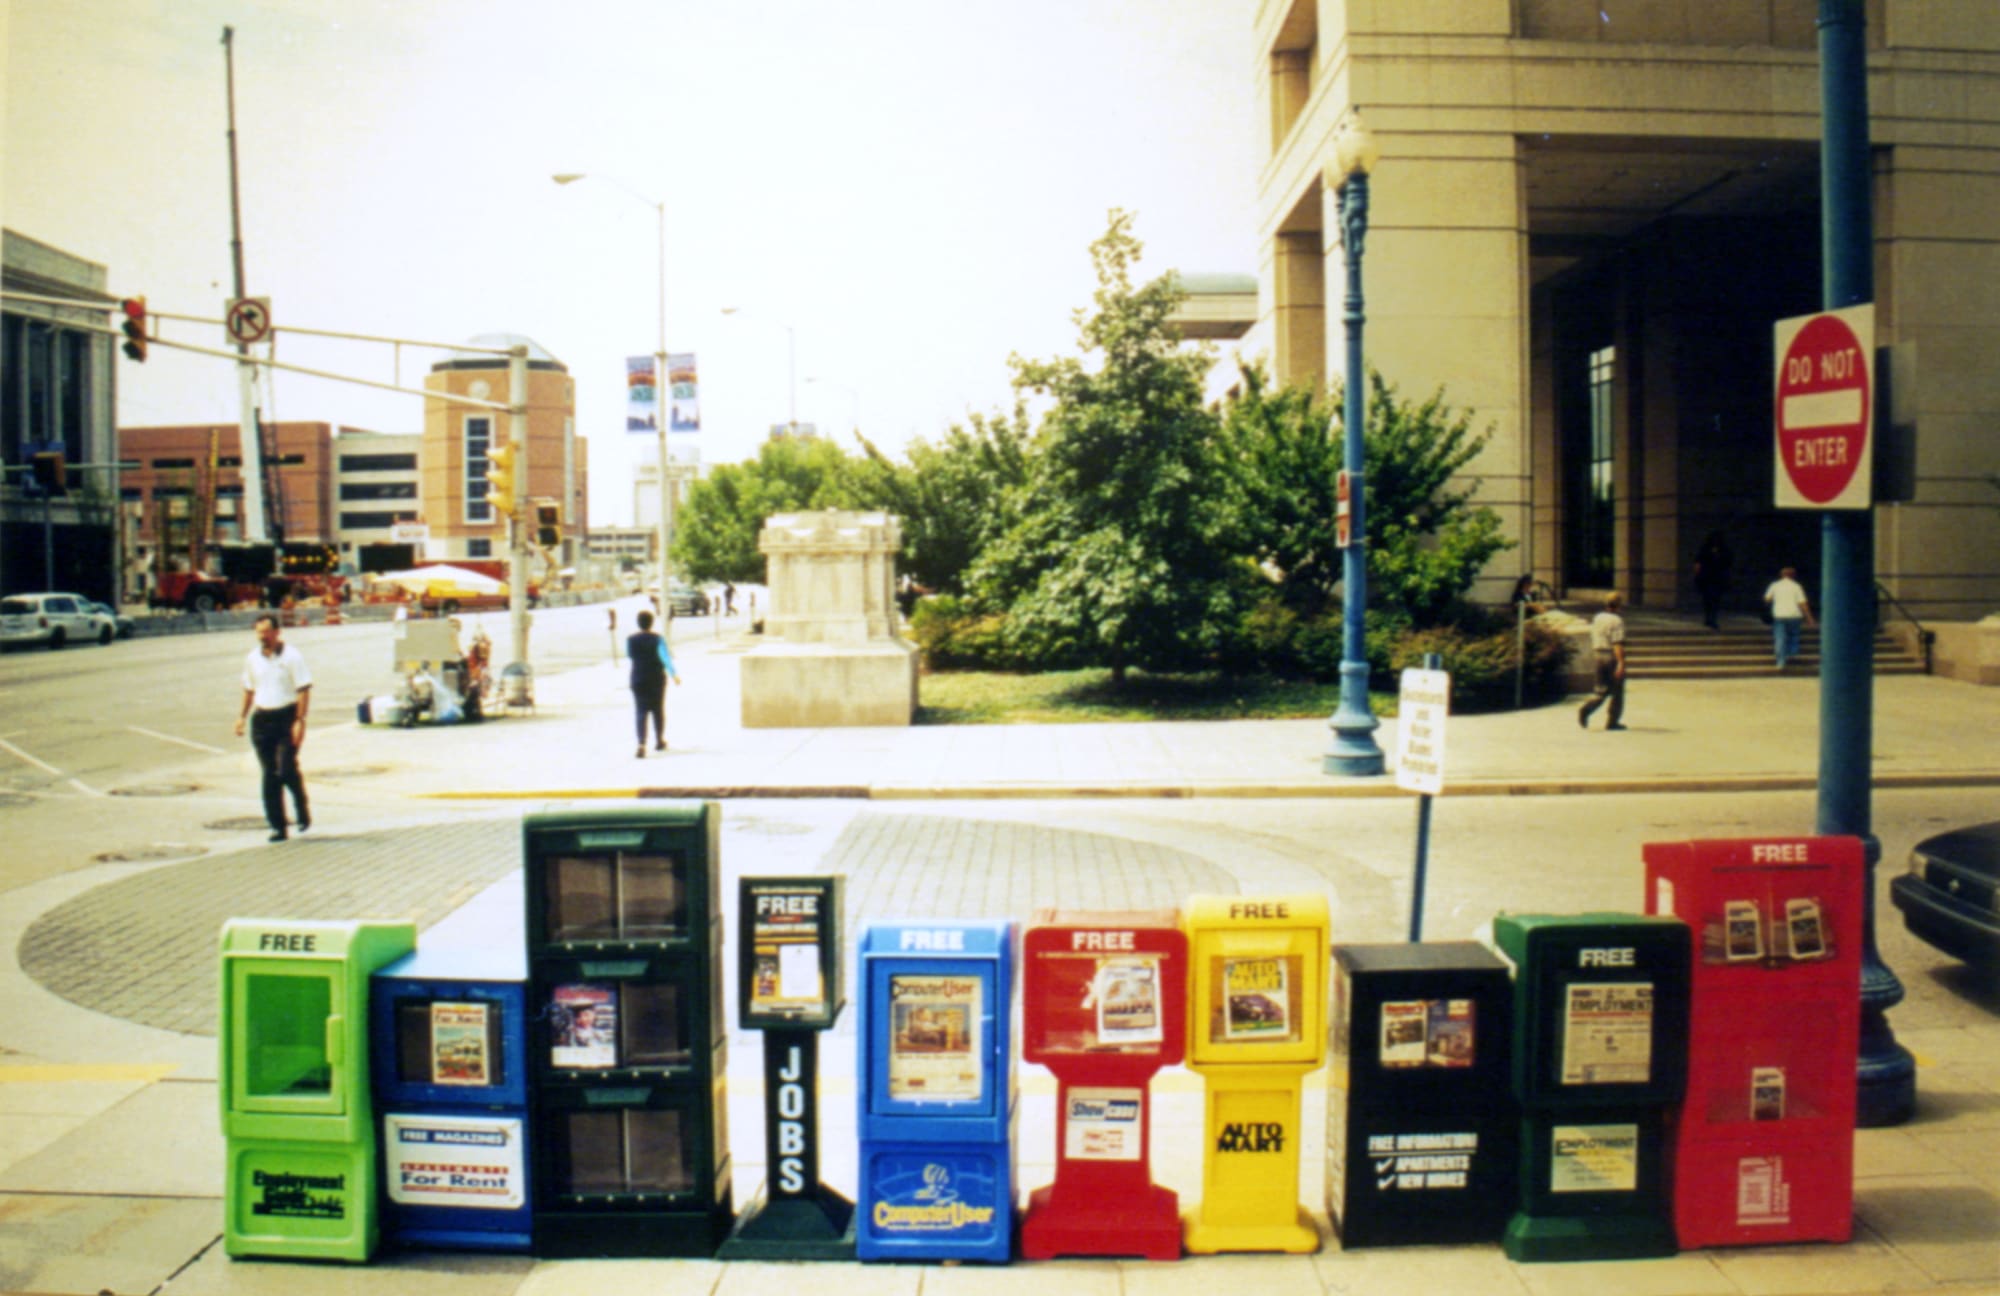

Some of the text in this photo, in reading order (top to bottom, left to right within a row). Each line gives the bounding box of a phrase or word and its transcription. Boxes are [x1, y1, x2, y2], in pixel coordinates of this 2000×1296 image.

[1788, 348, 1857, 385] DO NOT
[1794, 436, 1849, 467] ENTER
[1752, 844, 1808, 862] FREE
[757, 896, 818, 915] FREE
[1229, 902, 1289, 919] FREE
[259, 933, 316, 952] FREE
[901, 930, 964, 950] FREE
[1072, 931, 1135, 950] FREE
[1579, 947, 1635, 967] FREE
[779, 1046, 805, 1193] JOBS
[1224, 1122, 1284, 1138] AUTO
[1217, 1136, 1286, 1152] MART
[401, 1171, 507, 1188] For Rent
